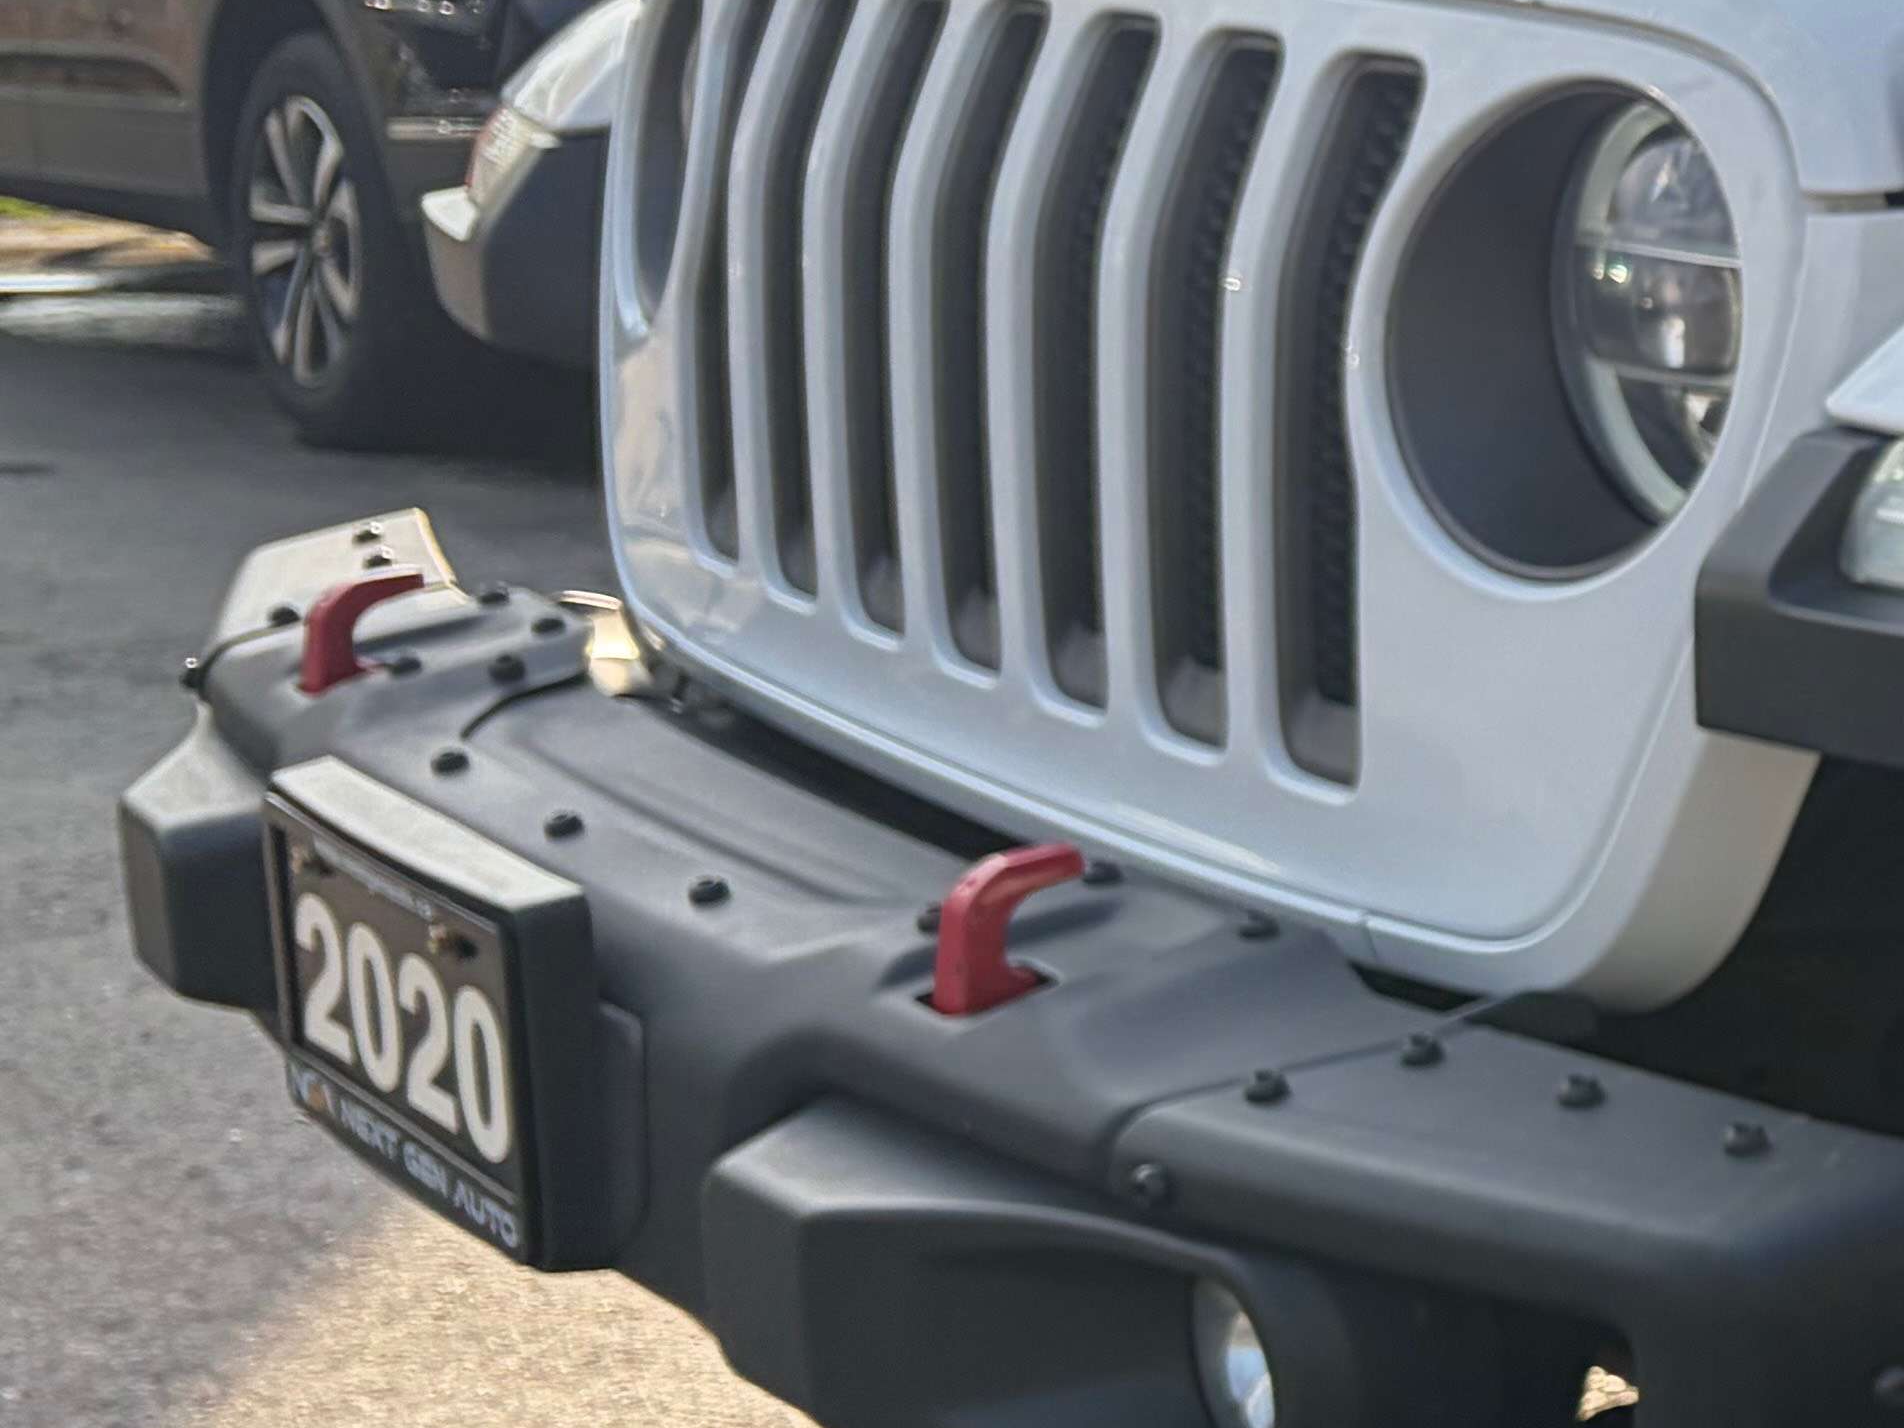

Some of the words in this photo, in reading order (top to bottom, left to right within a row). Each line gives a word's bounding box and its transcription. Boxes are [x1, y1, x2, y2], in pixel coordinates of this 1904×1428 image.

[295, 892, 508, 1164] 2020
[340, 1096, 398, 1160] NEXT
[453, 1179, 519, 1248] AUTO
